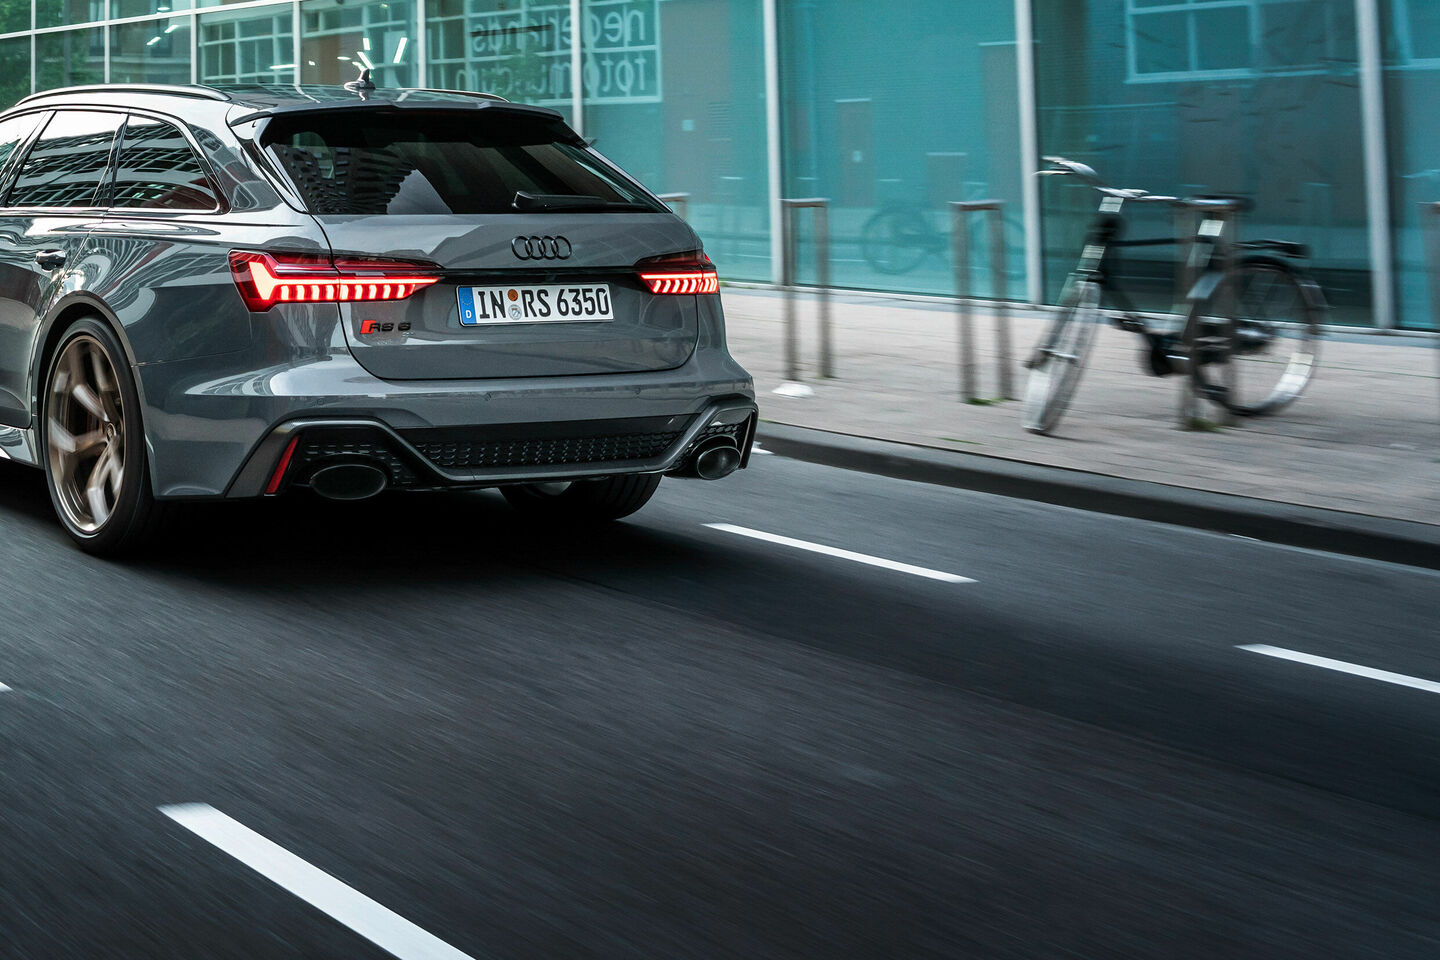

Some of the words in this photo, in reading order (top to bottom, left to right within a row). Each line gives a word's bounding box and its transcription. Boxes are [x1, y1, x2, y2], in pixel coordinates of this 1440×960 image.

[478, 291, 506, 319] IN
[523, 290, 551, 317] RS
[556, 288, 609, 316] 6350
[465, 310, 472, 319] D
[364, 321, 394, 333] RS
